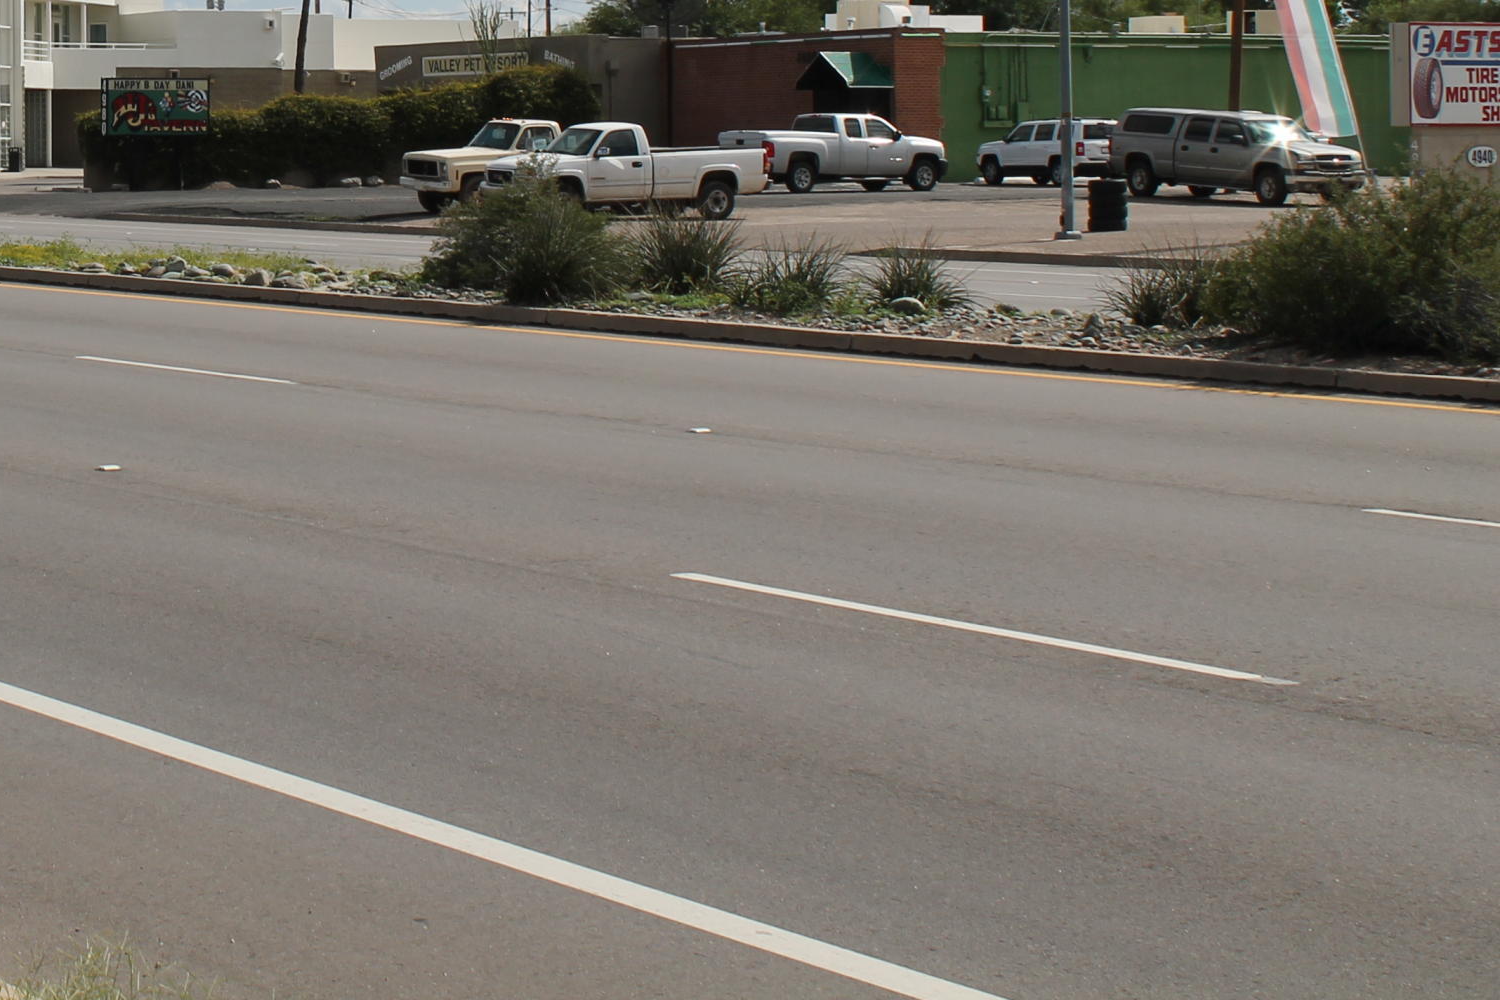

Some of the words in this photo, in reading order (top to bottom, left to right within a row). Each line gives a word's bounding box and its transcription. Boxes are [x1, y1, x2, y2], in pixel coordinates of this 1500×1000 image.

[379, 55, 413, 81] GROOMING
[428, 58, 461, 73] VALLEY
[464, 57, 481, 71] PET
[484, 54, 524, 71] SORT
[1466, 68, 1499, 83] TIRE
[114, 81, 140, 89] HAPPY
[154, 80, 170, 88] DAY
[1471, 150, 1493, 164] 4940
